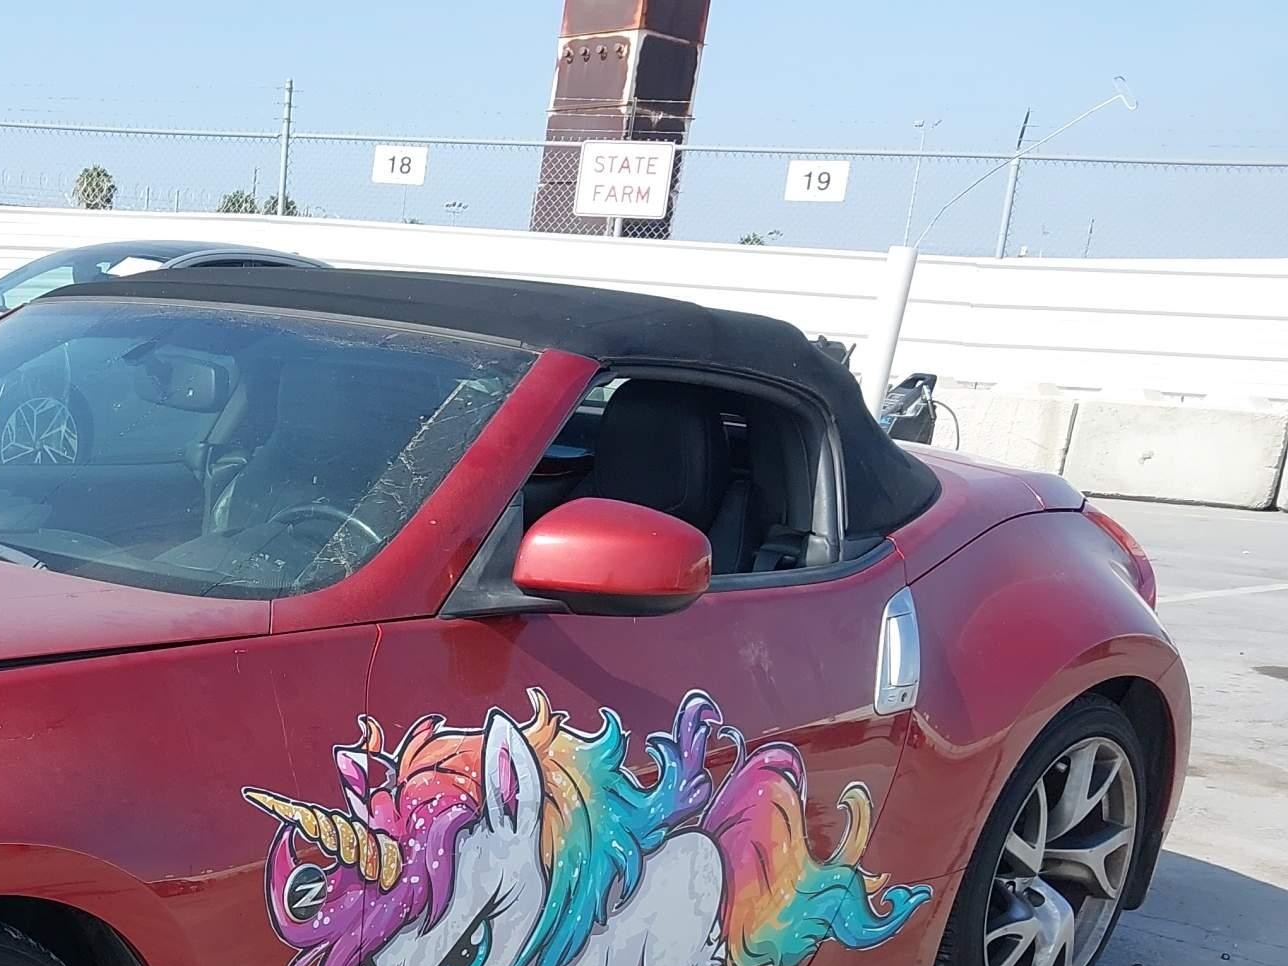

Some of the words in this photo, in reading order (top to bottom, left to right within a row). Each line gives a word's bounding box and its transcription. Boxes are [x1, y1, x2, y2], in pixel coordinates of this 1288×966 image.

[389, 157, 411, 174] 18
[594, 155, 659, 175] STATE
[804, 172, 831, 191] 19
[593, 184, 651, 204] FARM
